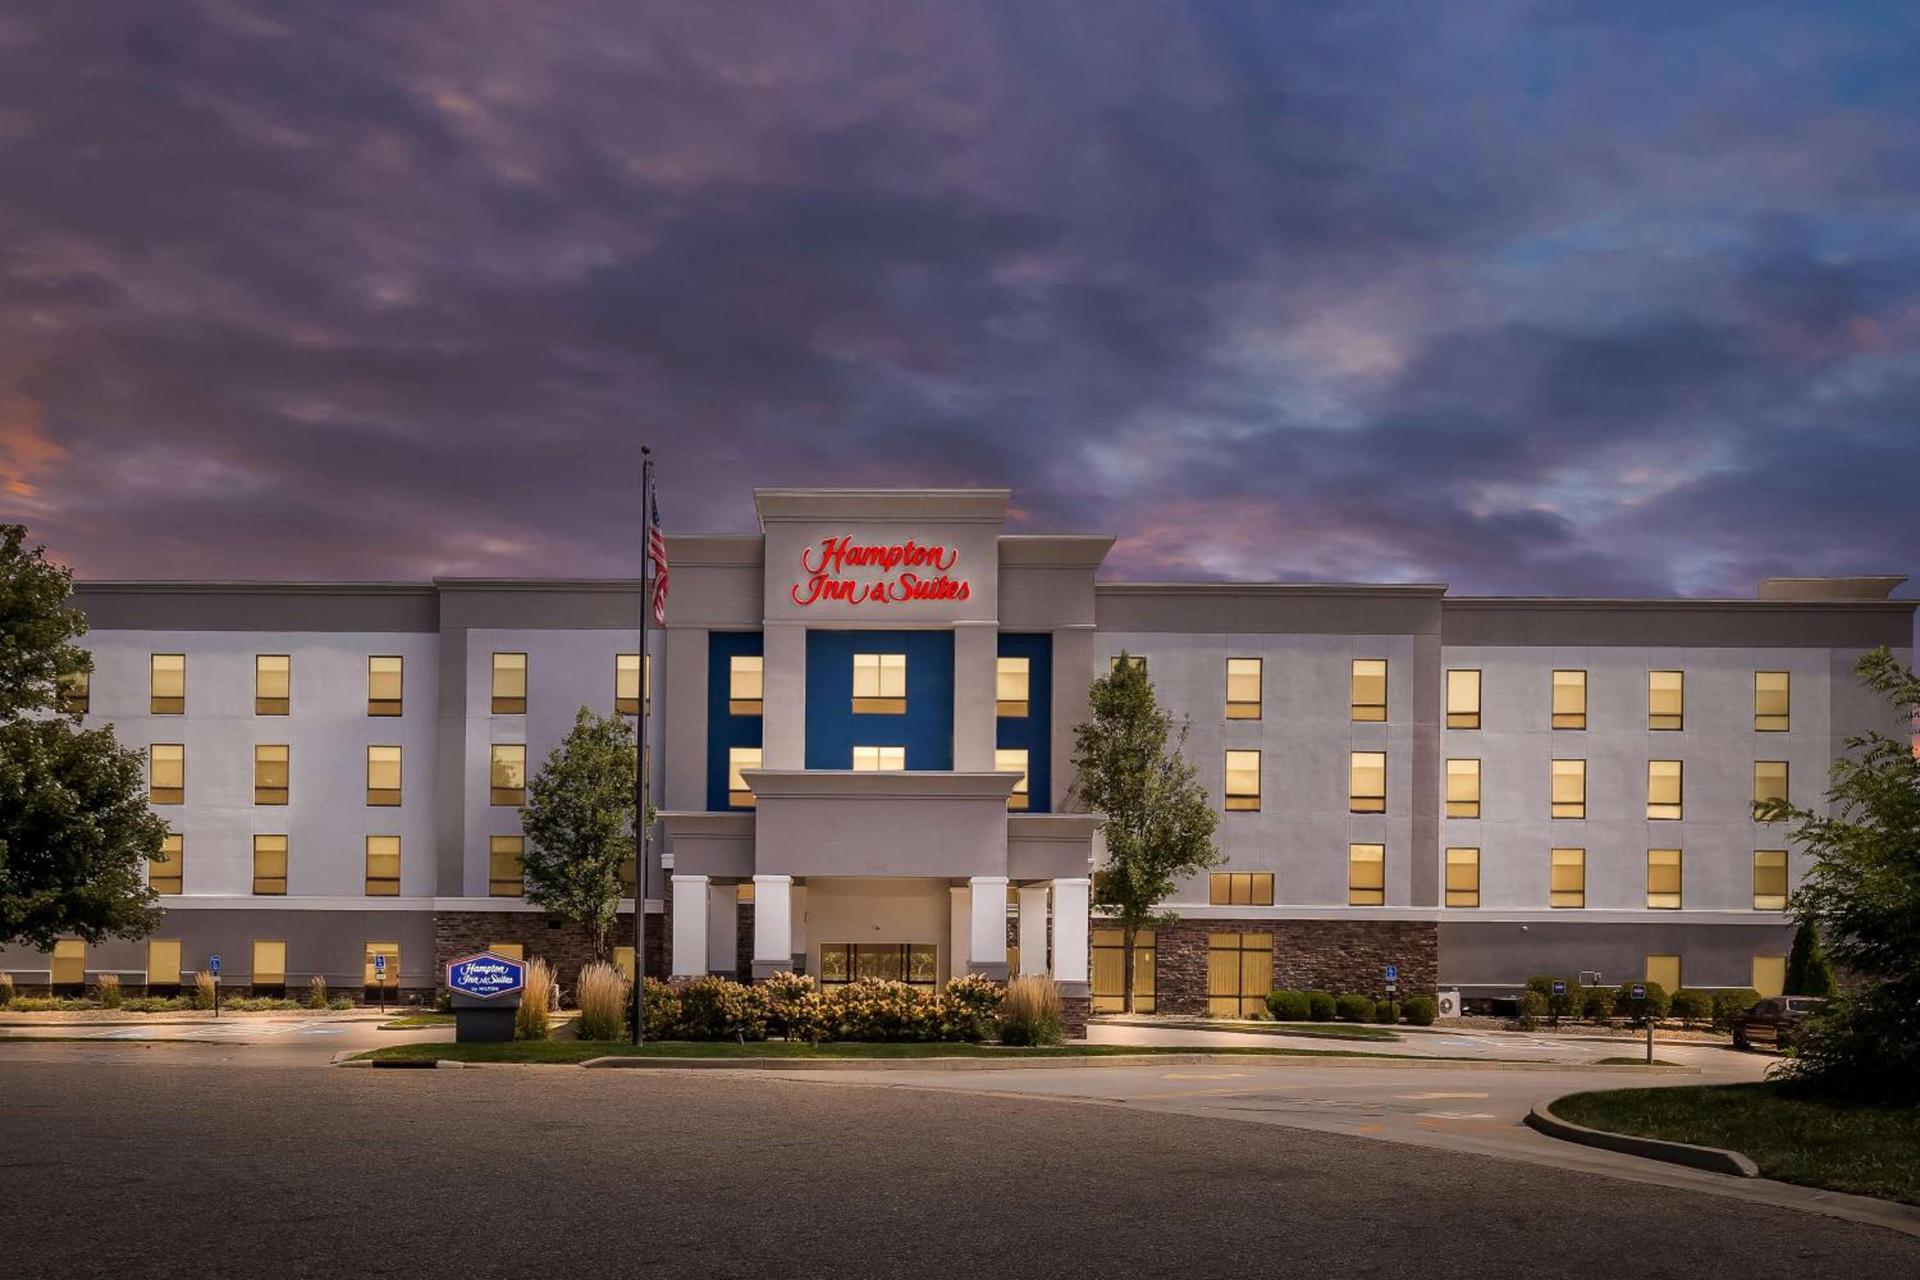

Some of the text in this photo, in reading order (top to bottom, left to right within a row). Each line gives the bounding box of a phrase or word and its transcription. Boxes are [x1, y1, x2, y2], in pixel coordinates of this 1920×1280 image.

[802, 535, 958, 574] Hampton
[792, 571, 972, 606] Inn & Suites
[458, 974, 482, 985] Inn
[488, 974, 513, 984] Suites
[460, 963, 509, 975] Hampton
